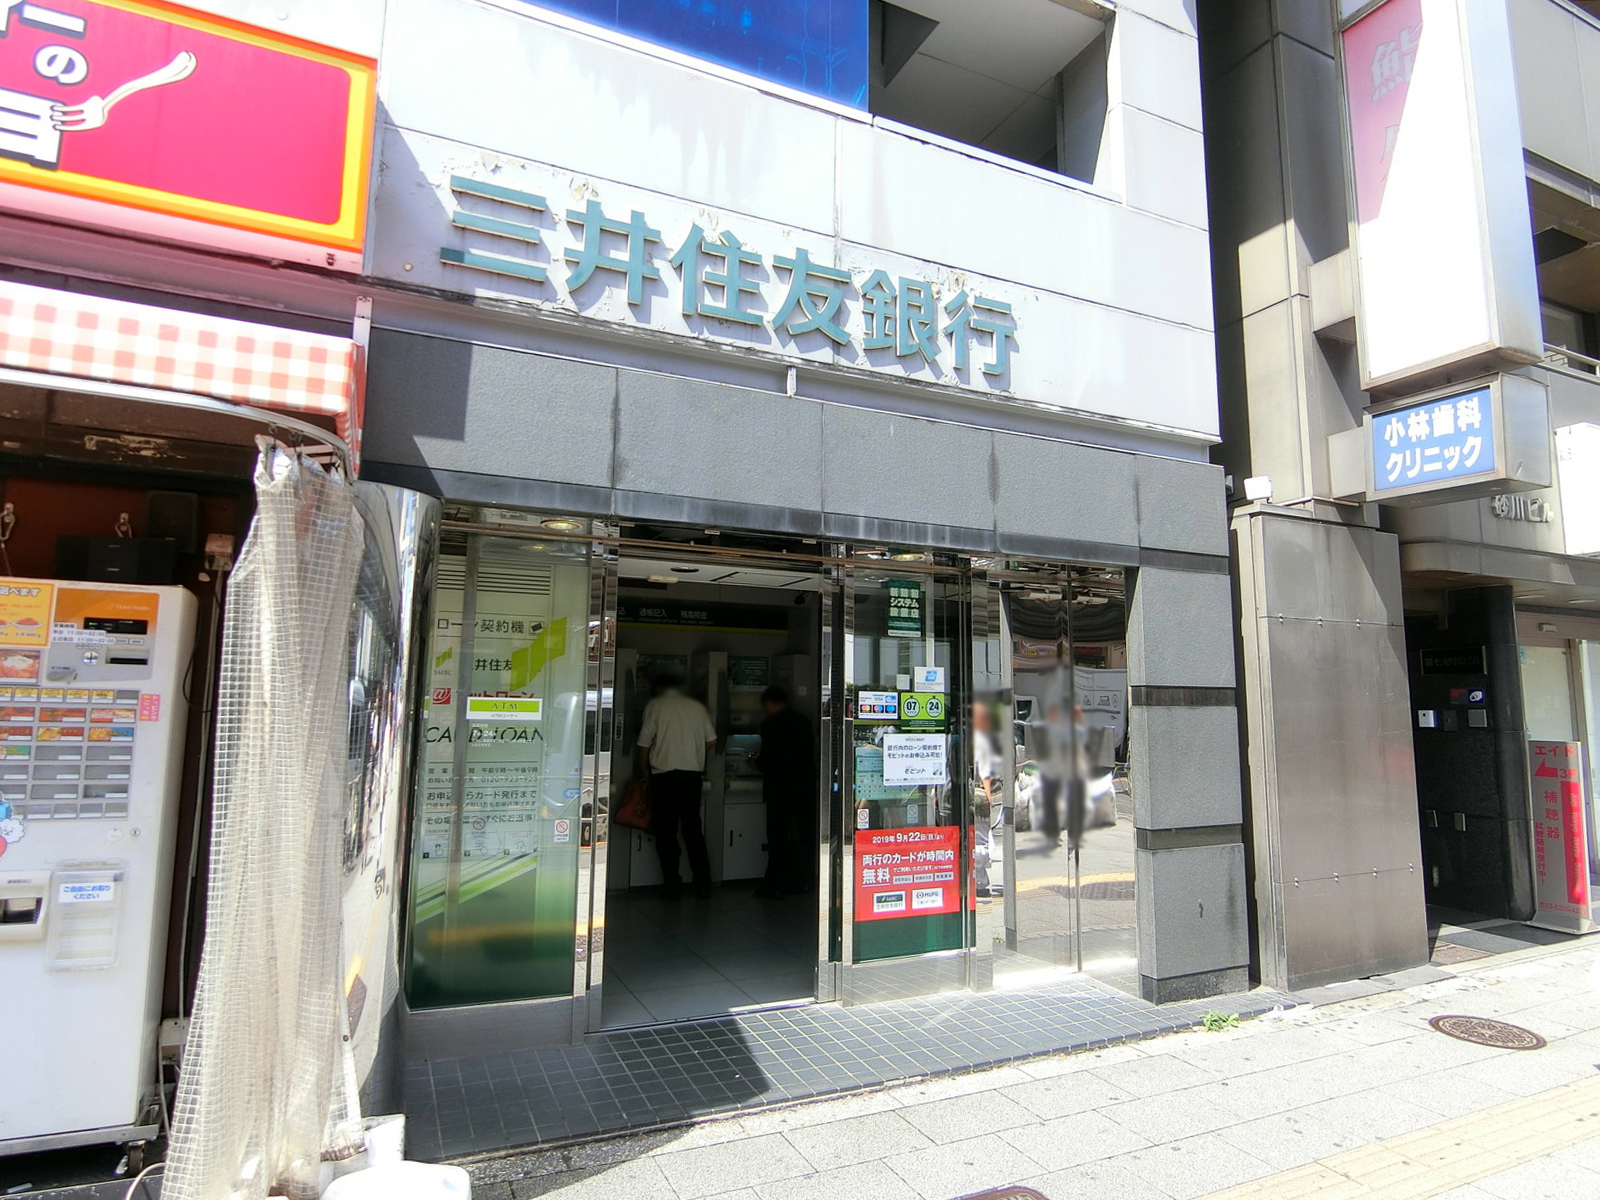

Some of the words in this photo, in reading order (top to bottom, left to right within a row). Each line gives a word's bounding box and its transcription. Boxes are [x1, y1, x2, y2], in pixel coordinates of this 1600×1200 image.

[34, 45, 89, 86] の
[440, 175, 1018, 377] 三井住友銀行
[1384, 397, 1482, 447] 小林歯科
[1385, 436, 1482, 483] クリニック
[1491, 494, 1554, 523] 砂川ビル
[890, 598, 919, 608] システム
[437, 618, 525, 635] ロー契約機
[491, 702, 519, 711] ATM
[906, 701, 917, 711] 07
[929, 701, 940, 711] 24
[426, 727, 482, 743] CAD
[1534, 745, 1575, 758] エイド
[428, 767, 475, 775] 営業間
[1559, 768, 1578, 779] 3F
[426, 790, 537, 801] お申込らカード発行まで
[1543, 790, 1560, 839] 補聴器
[862, 849, 954, 867] 両行のカードが時間内
[862, 867, 891, 885] 無料
